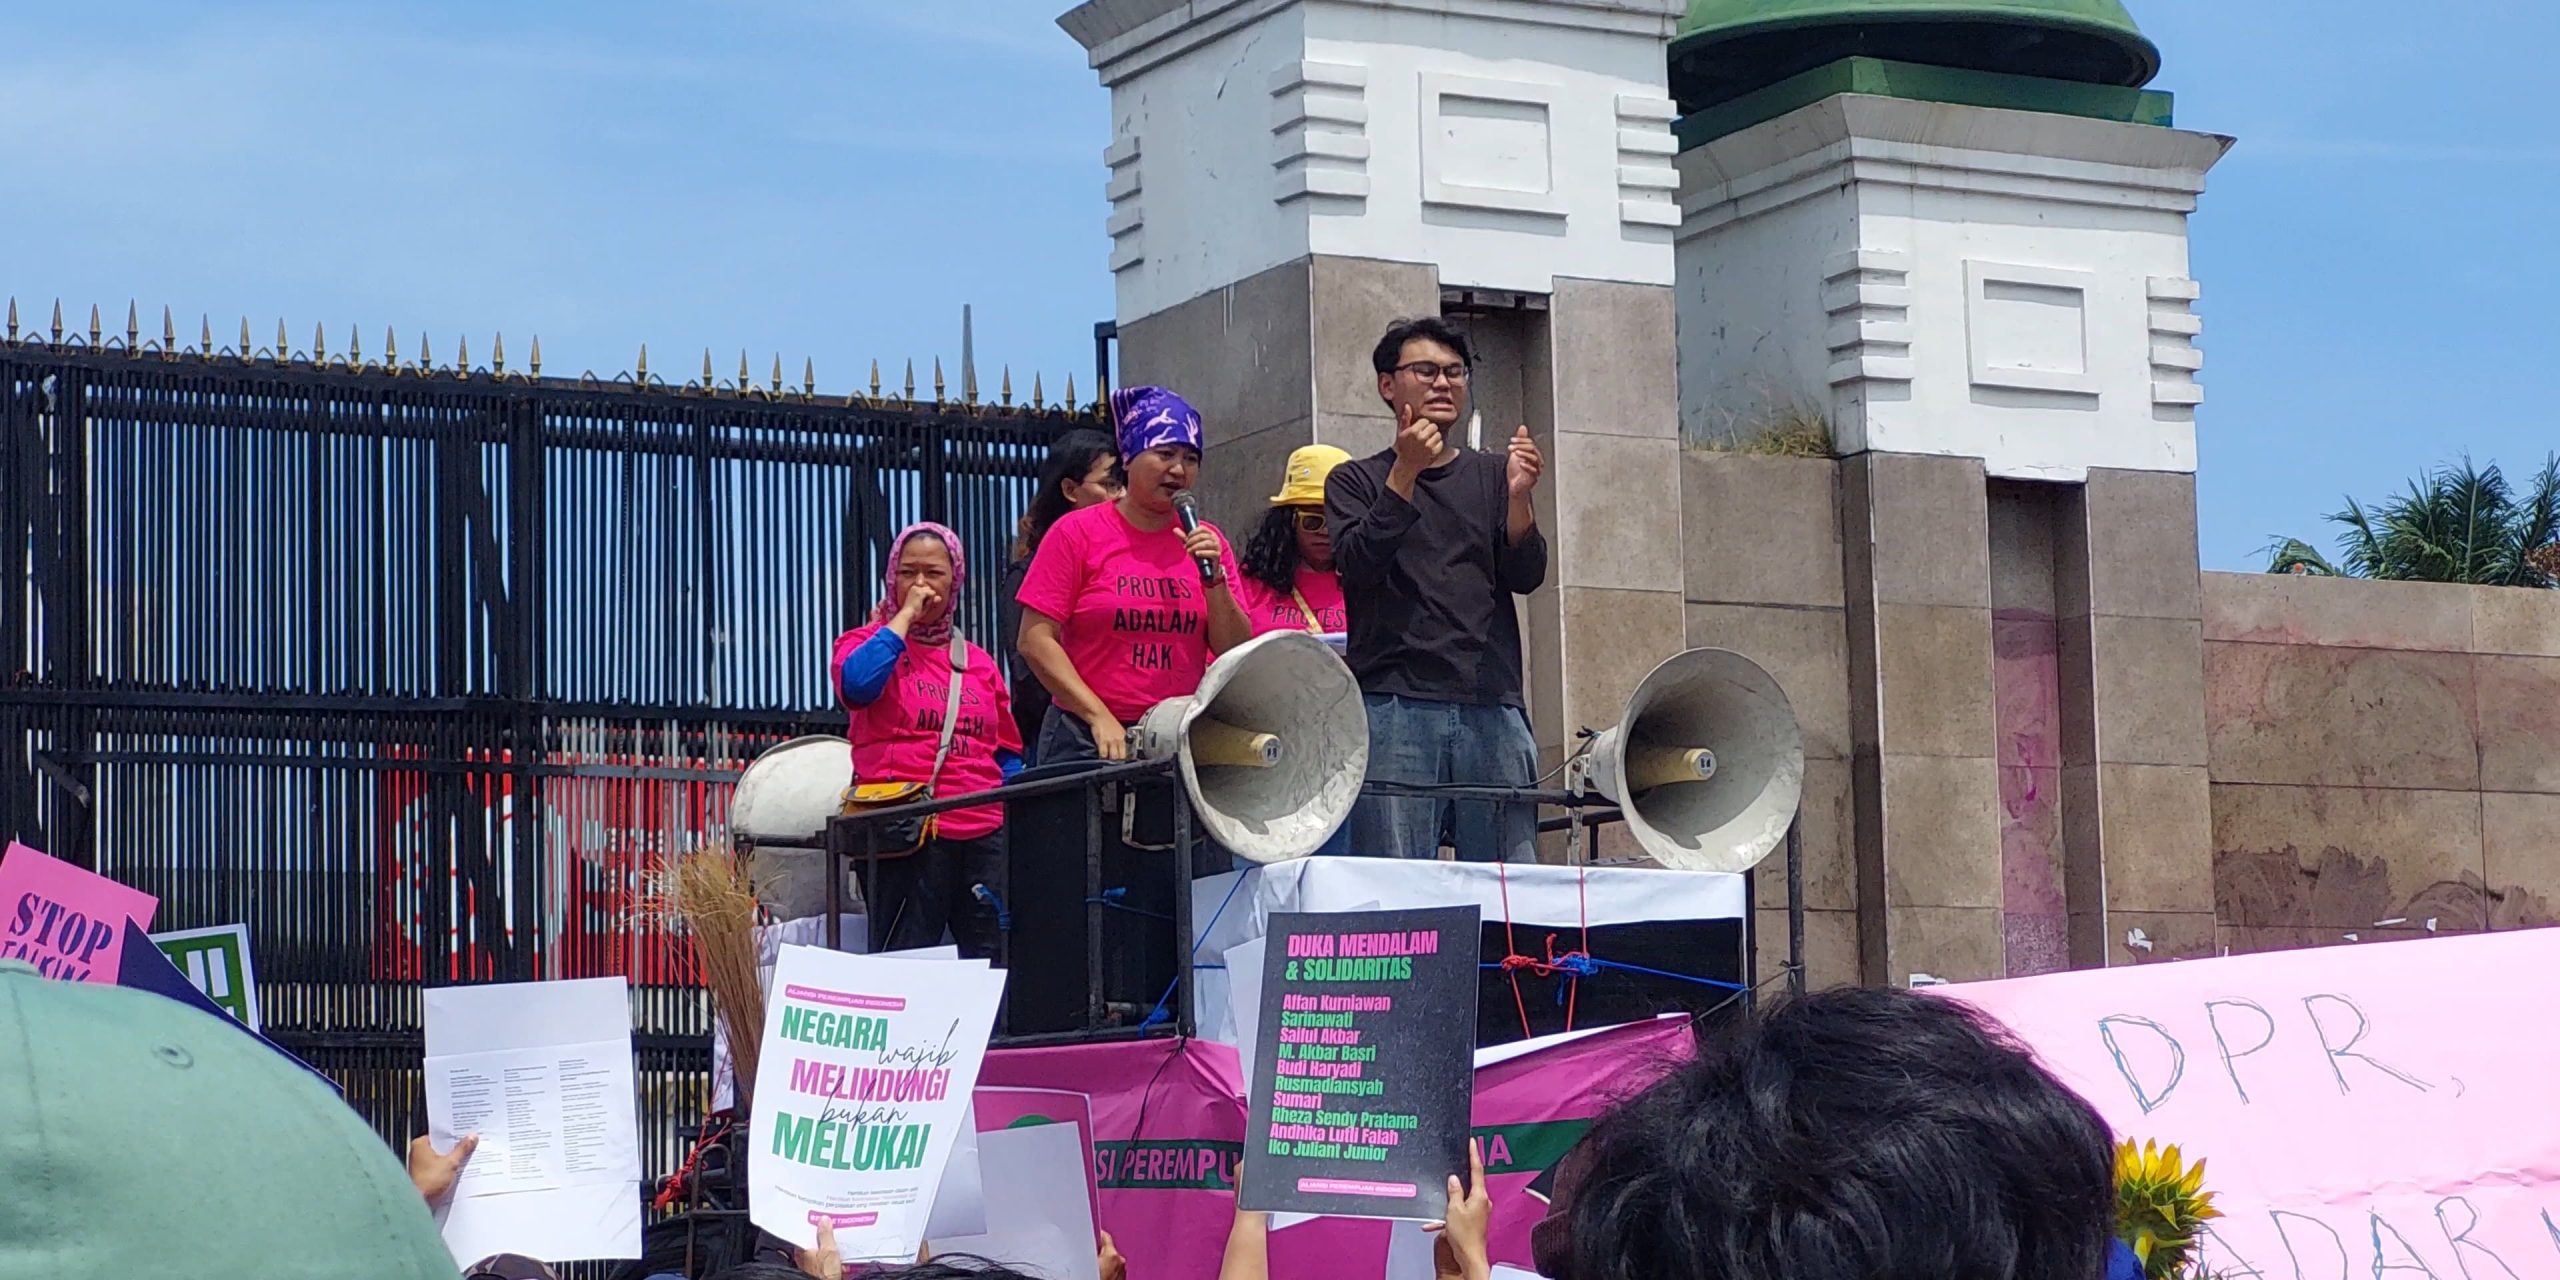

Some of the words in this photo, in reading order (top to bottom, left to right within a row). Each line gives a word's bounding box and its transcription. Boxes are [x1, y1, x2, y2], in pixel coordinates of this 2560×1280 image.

[1116, 576, 1192, 598] PROTES
[1113, 608, 1198, 634] ADALAH
[1132, 643, 1172, 669] HAK
[9, 892, 113, 964] STOP
[1287, 934, 1334, 957] DUKA
[1339, 930, 1438, 957] MENDALAM
[1285, 960, 1299, 981] &
[1303, 957, 1412, 981] SOLIDARITAS
[1320, 994, 1391, 1011] Kurniawan
[780, 1005, 888, 1051] NEGARA
[1281, 1010, 1353, 1027] Sarinawati
[1279, 1027, 1318, 1043] Saiful
[1320, 1028, 1360, 1044] Akbar
[878, 1017, 958, 1102] wajib
[1278, 1043, 1295, 1059] M.
[1298, 1044, 1338, 1060] Akbar
[1341, 1045, 1376, 1062] Basri
[790, 1058, 951, 1102] MELINDUNGI
[1276, 1059, 1307, 1076] Budi
[1310, 1061, 1362, 1079] Haryadi
[1275, 1076, 1384, 1097] Rusmadiansyah
[818, 1078, 908, 1132] bukan
[1273, 1091, 1323, 1109] Sumari
[1271, 1106, 1312, 1124] Rheza
[1315, 1109, 1358, 1127] Sendy
[1361, 1111, 1418, 1129] Pratama
[772, 1111, 931, 1171] MELUKAI
[1269, 1122, 1326, 1142] Andhika
[1362, 1127, 1399, 1146] Falah
[1268, 1139, 1290, 1155] Iko
[1292, 1141, 1341, 1159] Juliant
[1343, 1144, 1388, 1162] Junior
